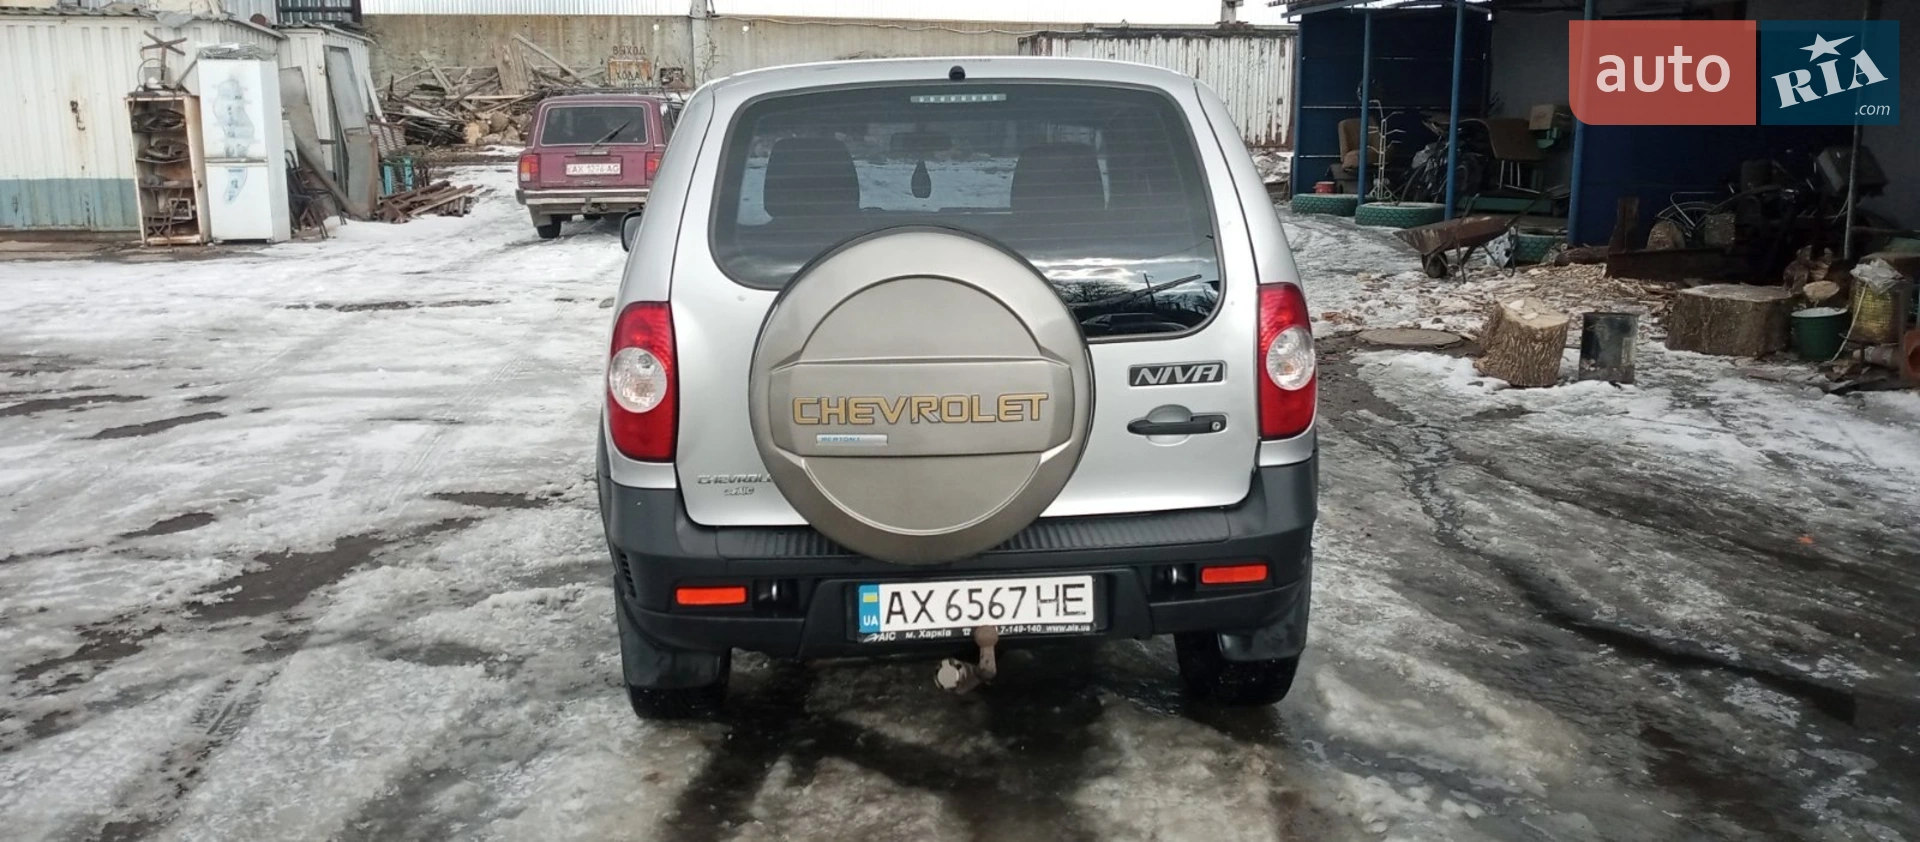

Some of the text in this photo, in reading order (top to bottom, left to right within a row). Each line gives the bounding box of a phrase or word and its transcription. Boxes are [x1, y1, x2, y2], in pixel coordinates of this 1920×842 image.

[1134, 364, 1219, 385] NIVA
[792, 392, 1049, 426] CHEVROLET
[885, 583, 1086, 625] AX 6567 HE
[863, 614, 879, 627] UA
